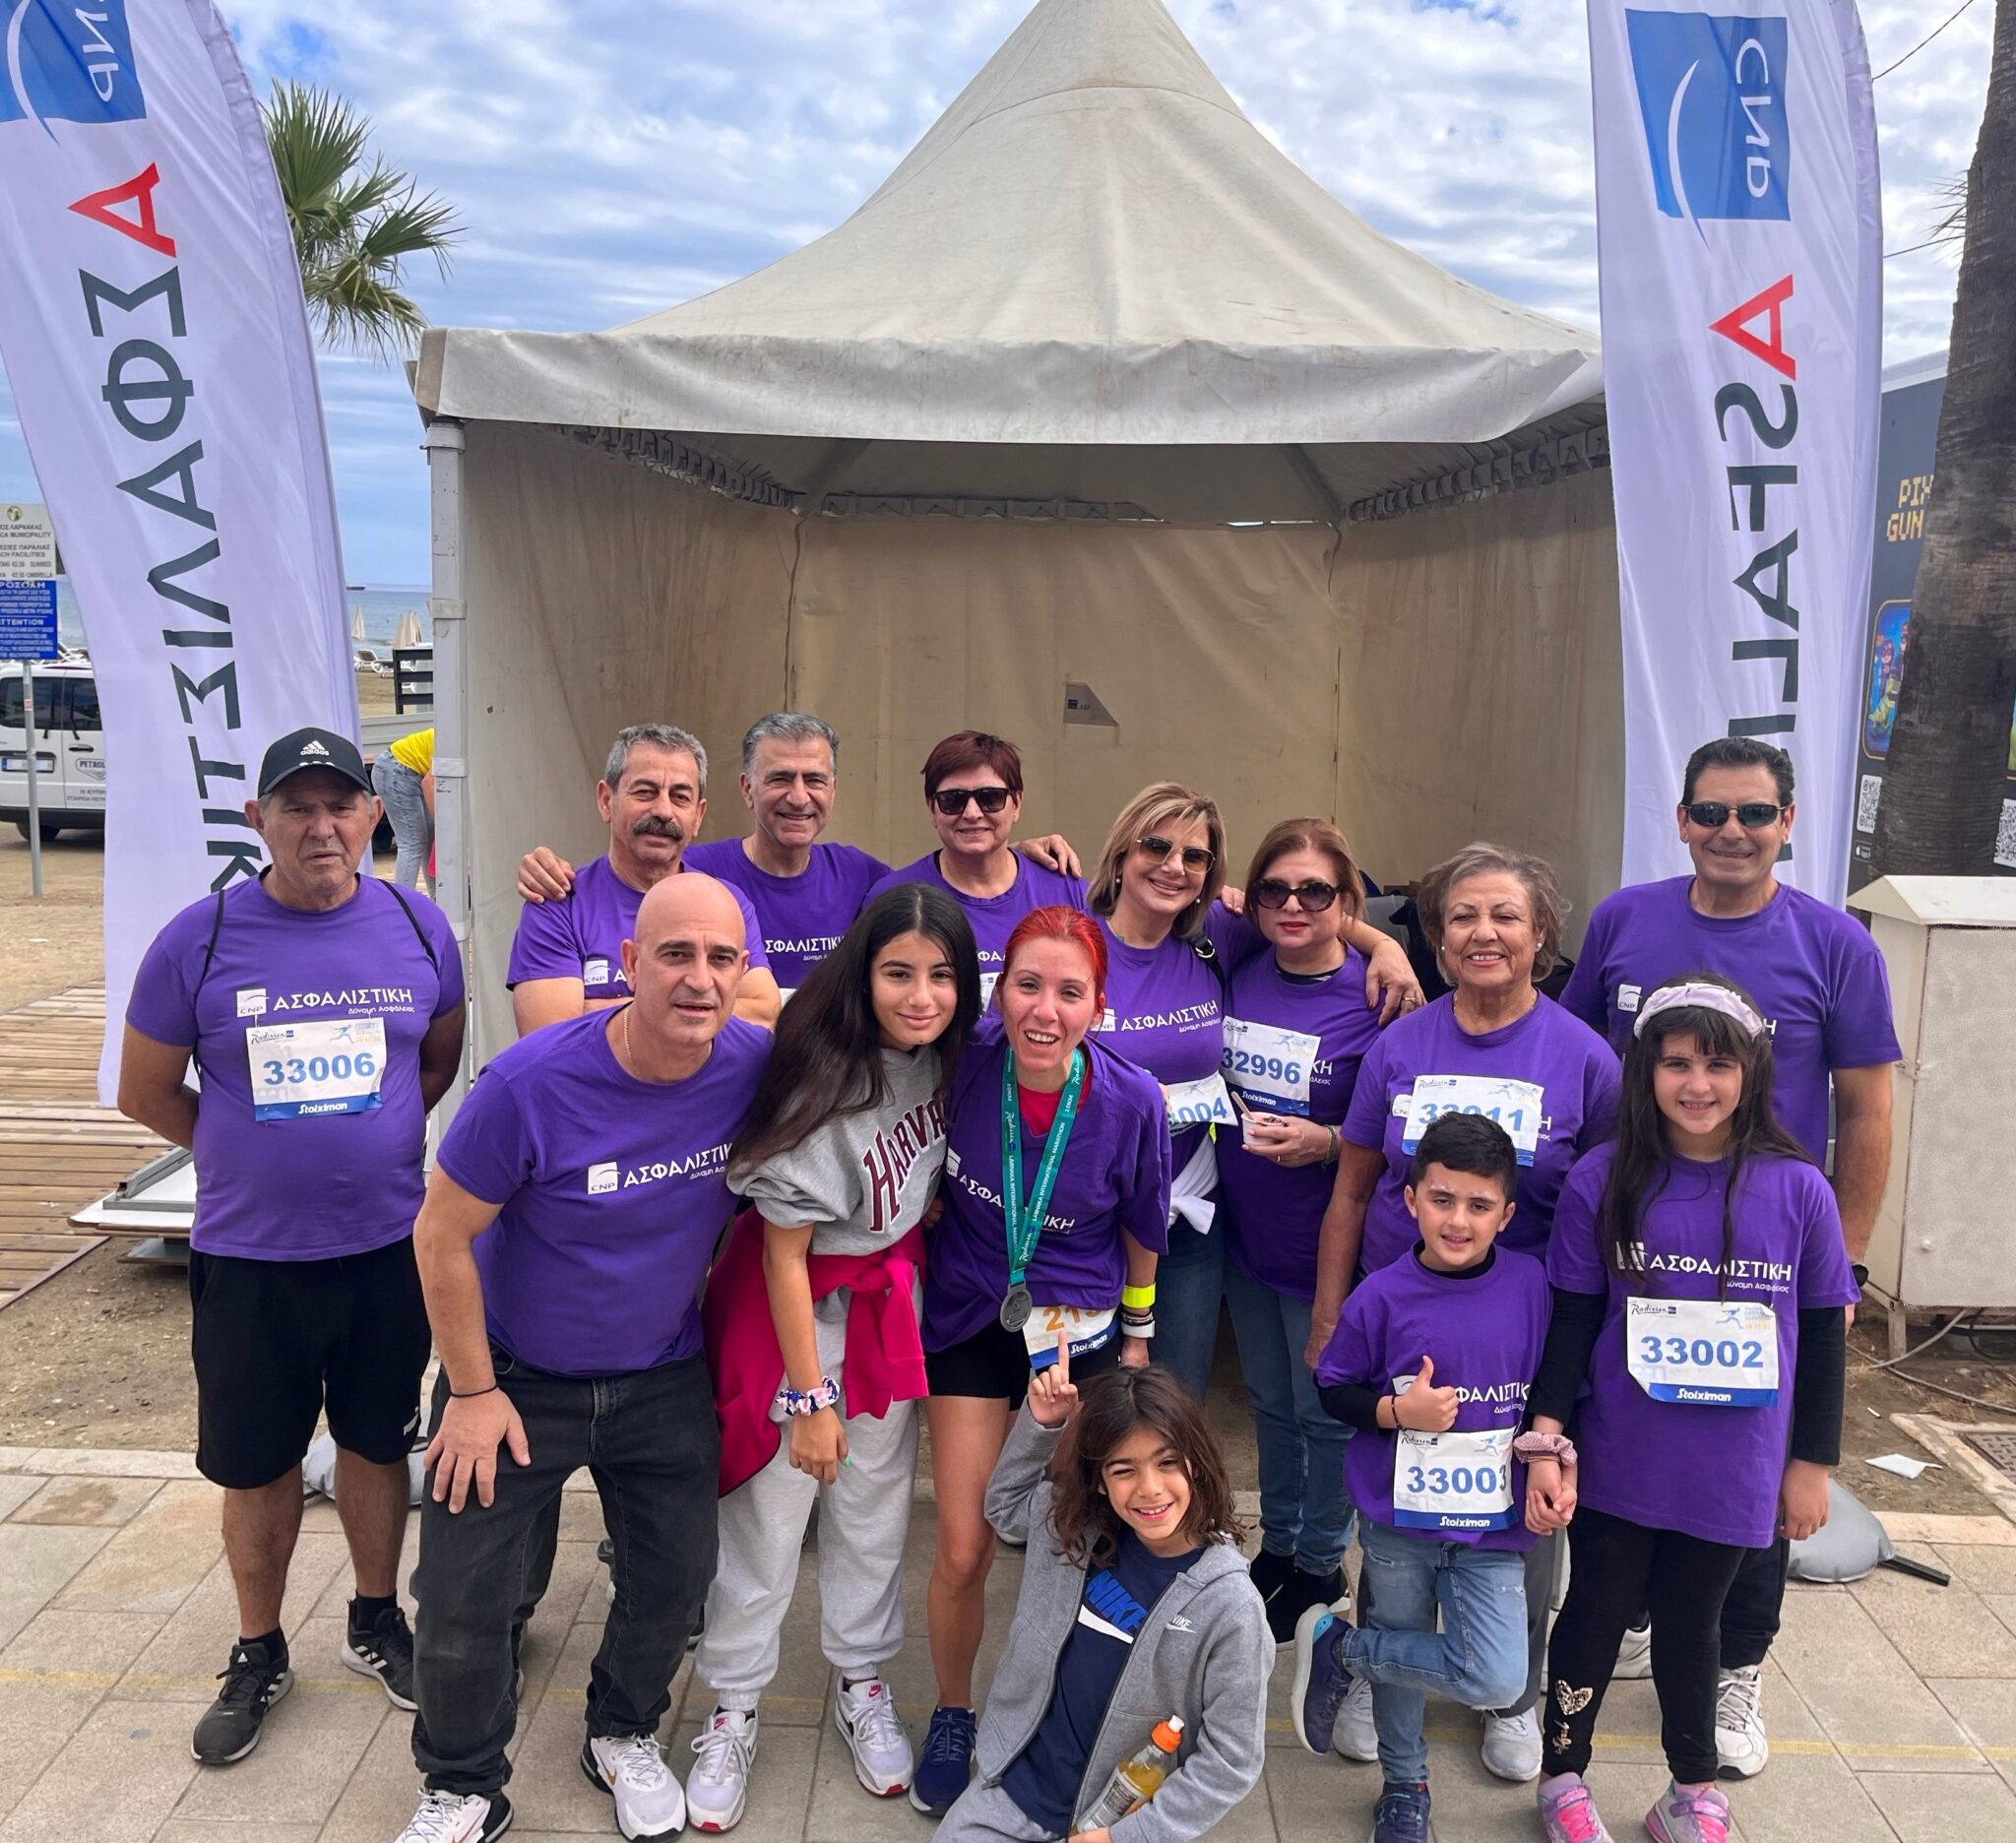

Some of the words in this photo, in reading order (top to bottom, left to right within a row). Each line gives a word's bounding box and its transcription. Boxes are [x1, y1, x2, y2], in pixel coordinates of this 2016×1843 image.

[1898, 475, 1934, 508] PIX
[1887, 509, 1924, 542] GUN
[80, 760, 105, 769] PETROL
[765, 935, 845, 953] ΣΦΑΛΙΣΤΙΚ
[240, 1006, 264, 1015] CNP
[273, 987, 412, 1011] ΑΣΦΑΛΙΣΤΙΚΗ
[1121, 1000, 1219, 1031] ΑΣΦΑΛΙΣΤΙΚΗ
[263, 1052, 375, 1086] 33006
[1222, 1048, 1301, 1085] 32996
[298, 1102, 347, 1114] Stoiximan
[1241, 1091, 1277, 1107] Stoiximan
[1051, 1122, 1065, 1154] MARATHON
[623, 1142, 732, 1188] ΑΣΦΑΛΙΣΤΙΚ
[862, 1099, 946, 1232] HARVA
[591, 1182, 615, 1191] CNP
[1649, 1254, 1793, 1282] ΑΣΦΑΛΙΣΤΙΚΗ
[1641, 1336, 1763, 1368] 33002
[1455, 1381, 1531, 1403] ΦΑΛΙΣΤΙΚ
[1677, 1387, 1732, 1402] Stoiximan
[1406, 1465, 1506, 1494] 33003
[1439, 1516, 1490, 1527] Stoiximan
[1086, 1569, 1148, 1636] NIKE
[1172, 1614, 1192, 1628] NIKE
